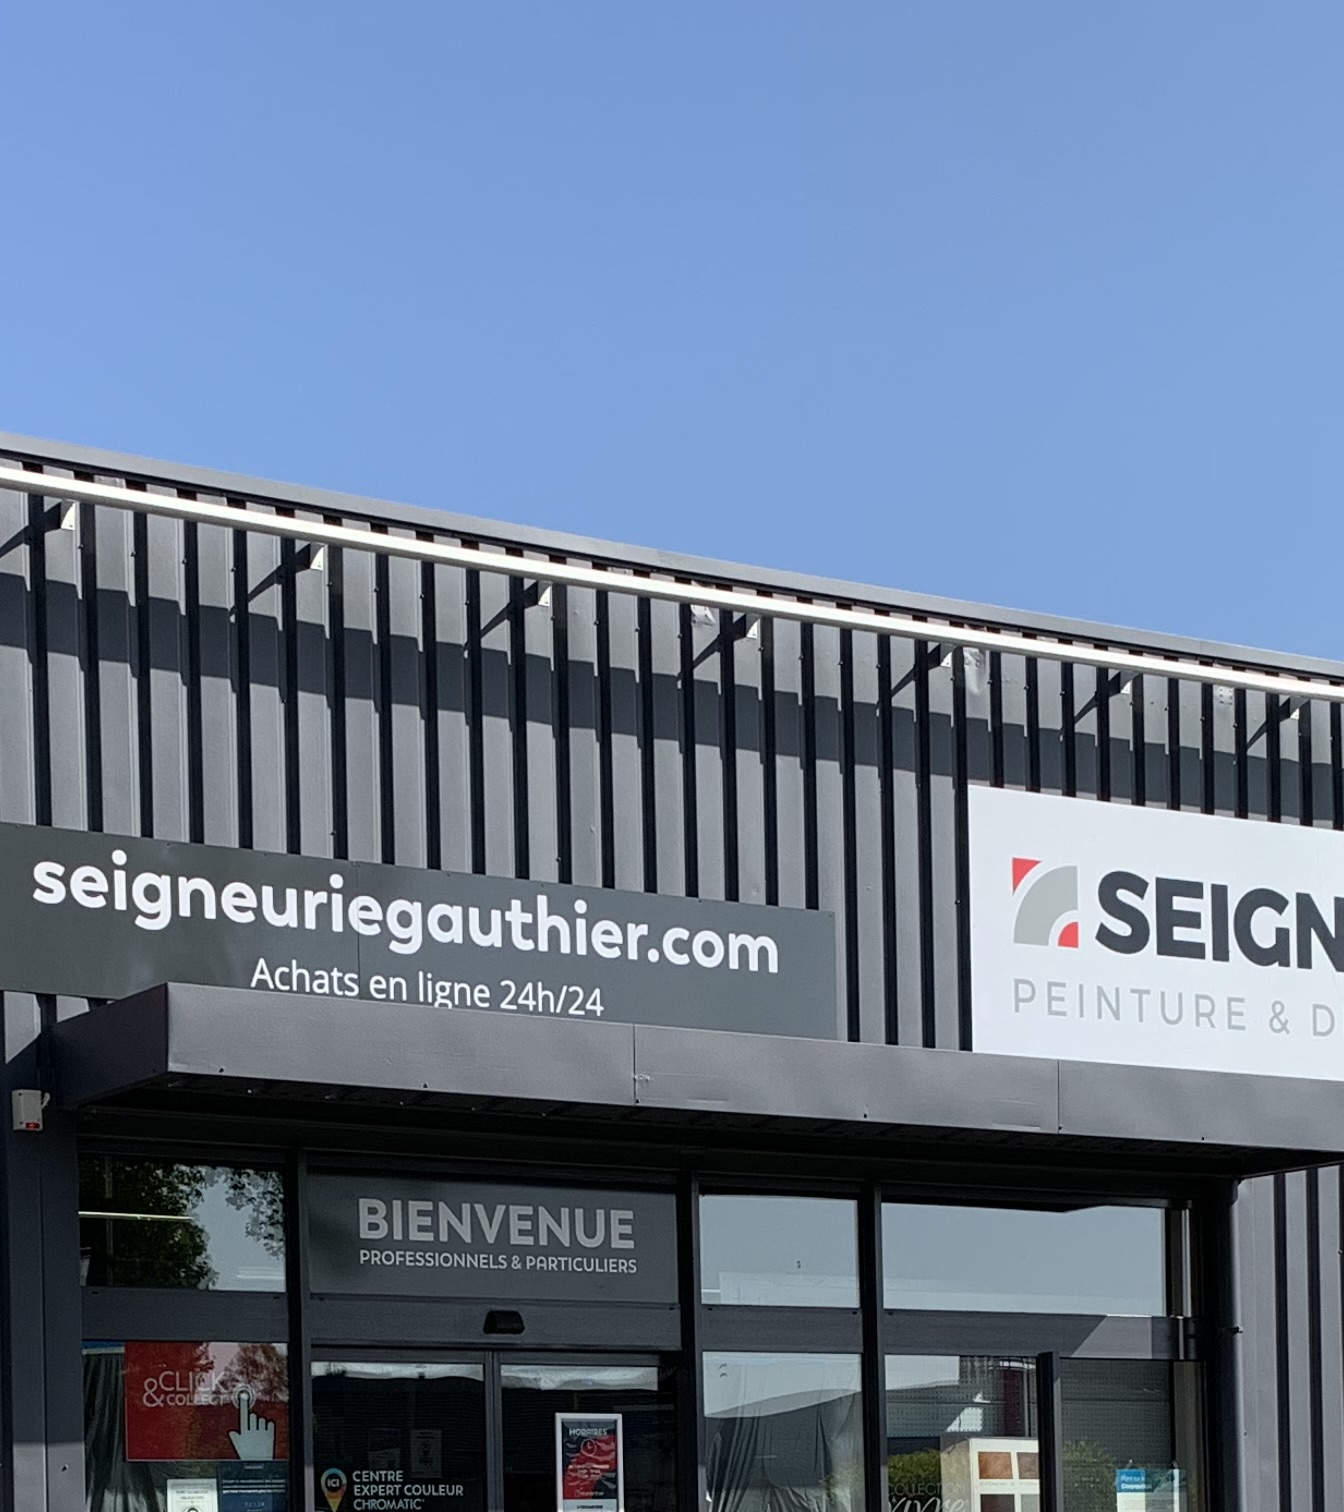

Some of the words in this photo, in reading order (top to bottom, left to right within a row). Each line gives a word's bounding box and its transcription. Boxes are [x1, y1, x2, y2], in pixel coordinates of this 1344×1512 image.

[33, 849, 780, 973] seigneuriegauthier.com
[251, 957, 360, 997] Achats
[369, 973, 407, 1001] en
[417, 970, 491, 1009] ligne
[499, 979, 605, 1017] 24h/24
[1013, 978, 1247, 1032] PEINTURE
[1268, 1001, 1291, 1036] &
[358, 1198, 635, 1249] BIENVENUE
[359, 1250, 507, 1270] PROFESSIONNELS
[511, 1255, 522, 1270] &
[526, 1256, 637, 1274] PARTICULIERS
[143, 1378, 163, 1407] &
[166, 1393, 227, 1407] COLLECT
[158, 1370, 229, 1392] CLICK
[327, 1478, 340, 1488] ICI
[352, 1470, 404, 1482] CENTRE
[353, 1484, 401, 1496] EXPERT
[404, 1485, 463, 1496] COULEUR
